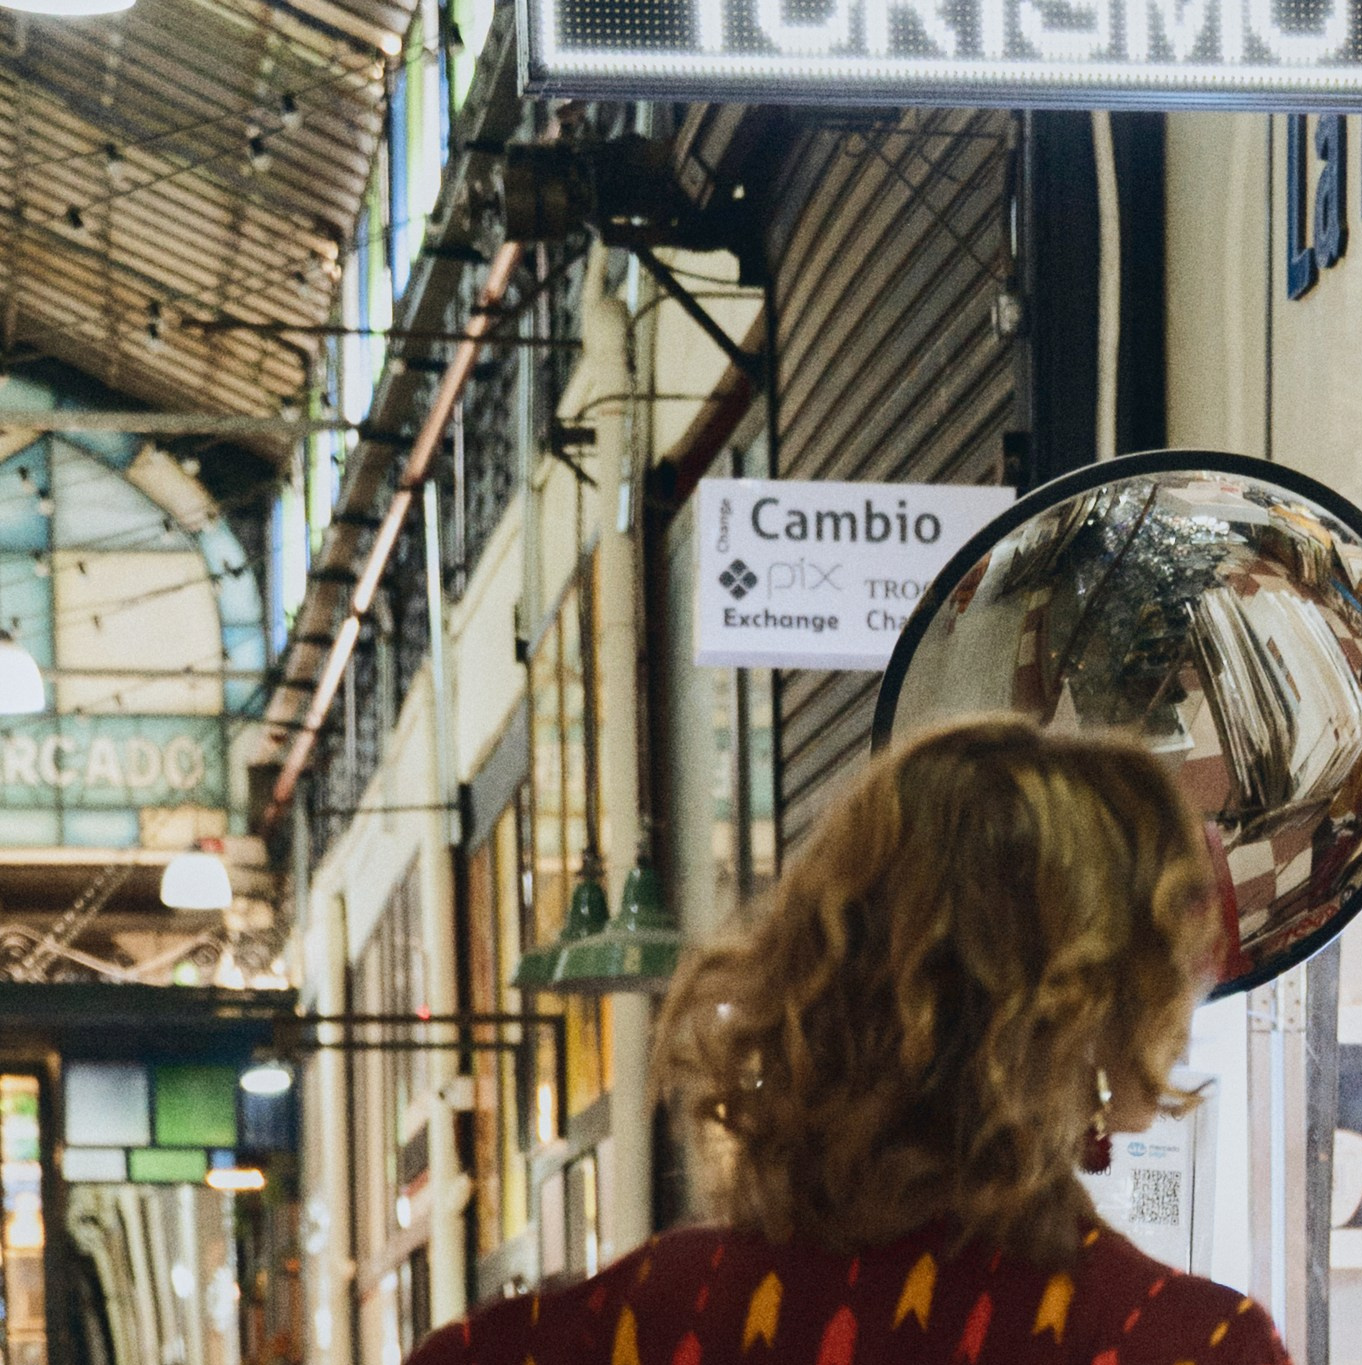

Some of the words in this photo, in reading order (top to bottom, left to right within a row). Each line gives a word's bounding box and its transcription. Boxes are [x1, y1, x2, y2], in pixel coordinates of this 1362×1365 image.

[752, 497, 942, 544] Cambio
[724, 607, 840, 633] Exchange
[867, 609, 906, 632] Cha
